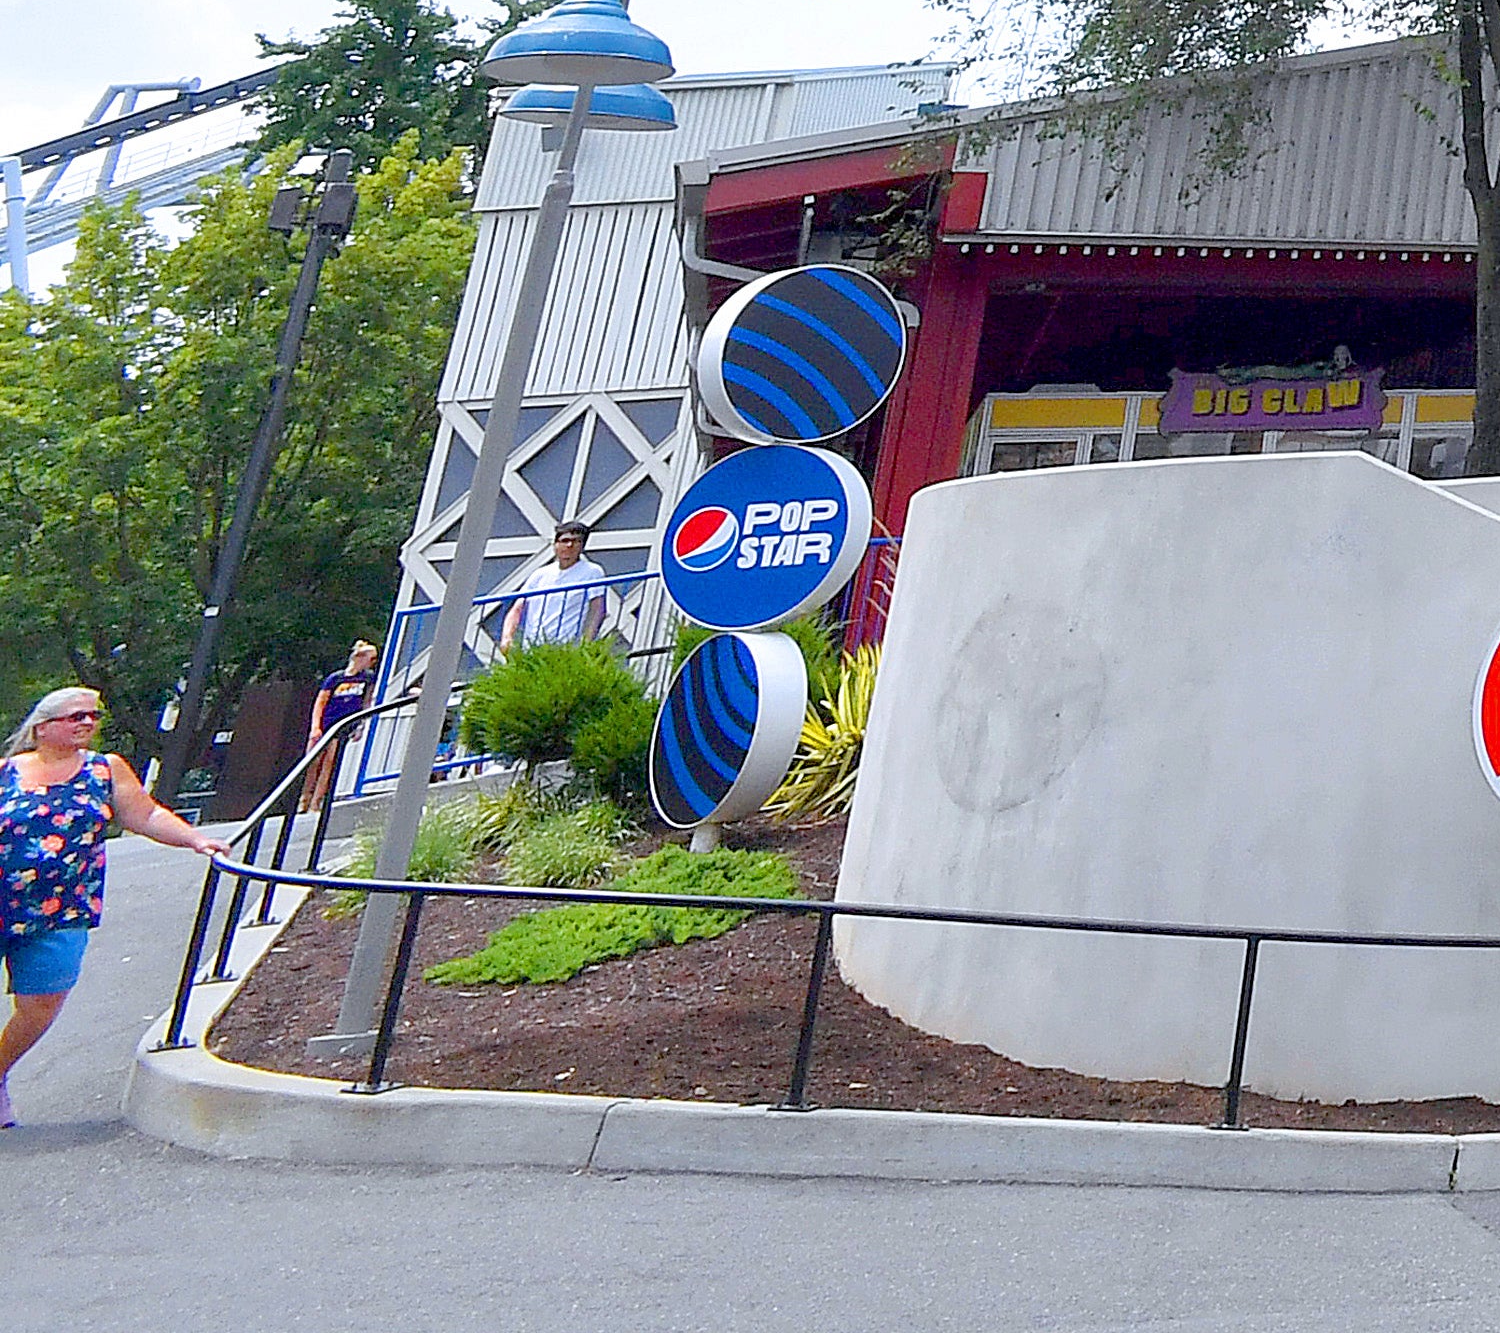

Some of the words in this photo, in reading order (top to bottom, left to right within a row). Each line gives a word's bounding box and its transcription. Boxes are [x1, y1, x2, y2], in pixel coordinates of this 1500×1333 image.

[1193, 388, 1250, 415] BIG
[1262, 380, 1361, 414] CLAW
[742, 499, 839, 535] POP
[737, 532, 833, 569] STAR
